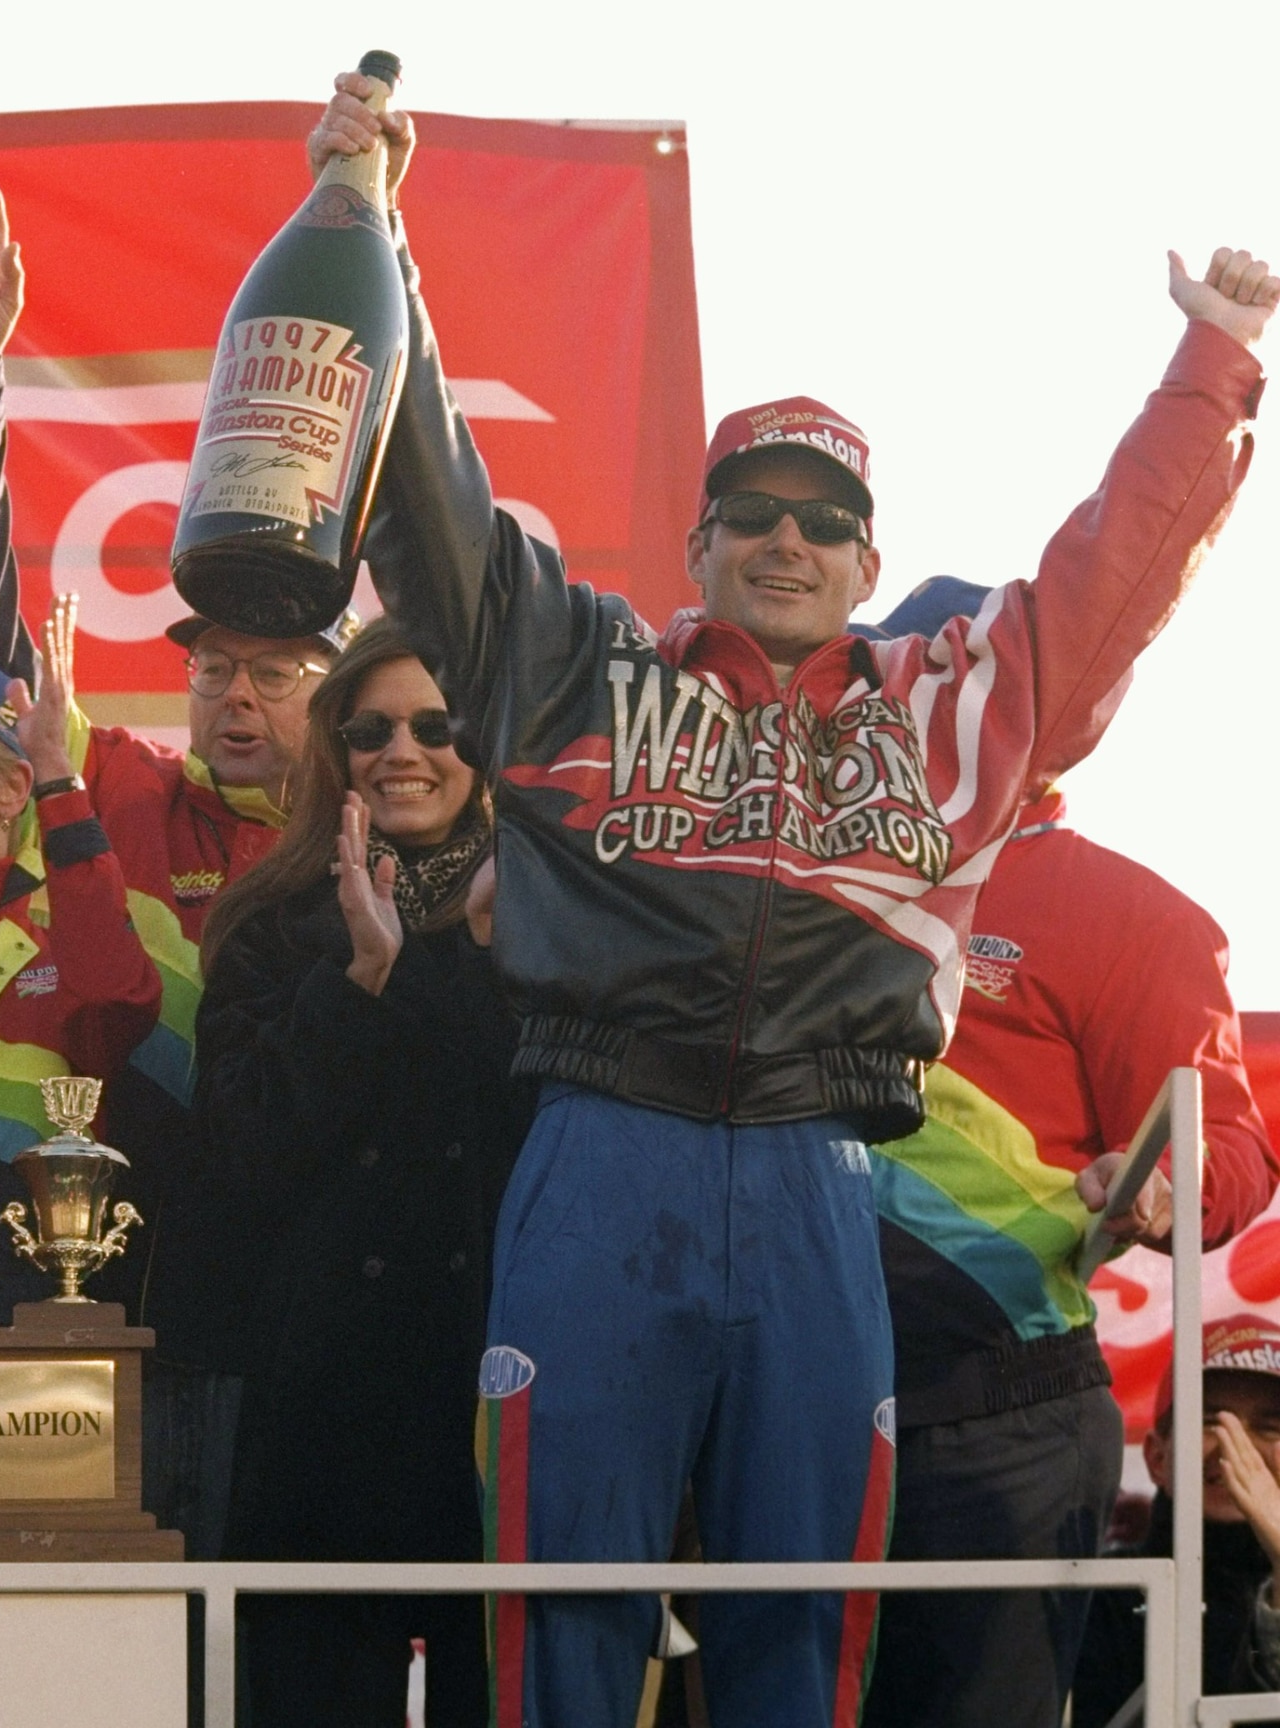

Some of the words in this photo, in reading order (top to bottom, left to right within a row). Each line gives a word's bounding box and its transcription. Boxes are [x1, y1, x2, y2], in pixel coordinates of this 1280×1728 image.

[243, 321, 331, 352] 1997
[214, 355, 356, 411] CHAMPION
[204, 410, 285, 437] Winston
[288, 415, 341, 446] Cup
[752, 412, 816, 436] NASCAR
[278, 435, 333, 463] Series
[242, 498, 305, 519] OTORSPORTS
[607, 660, 945, 827] WINSTON
[596, 804, 695, 863] CUP
[704, 792, 953, 887] CHAMPION
[170, 869, 225, 888] drick
